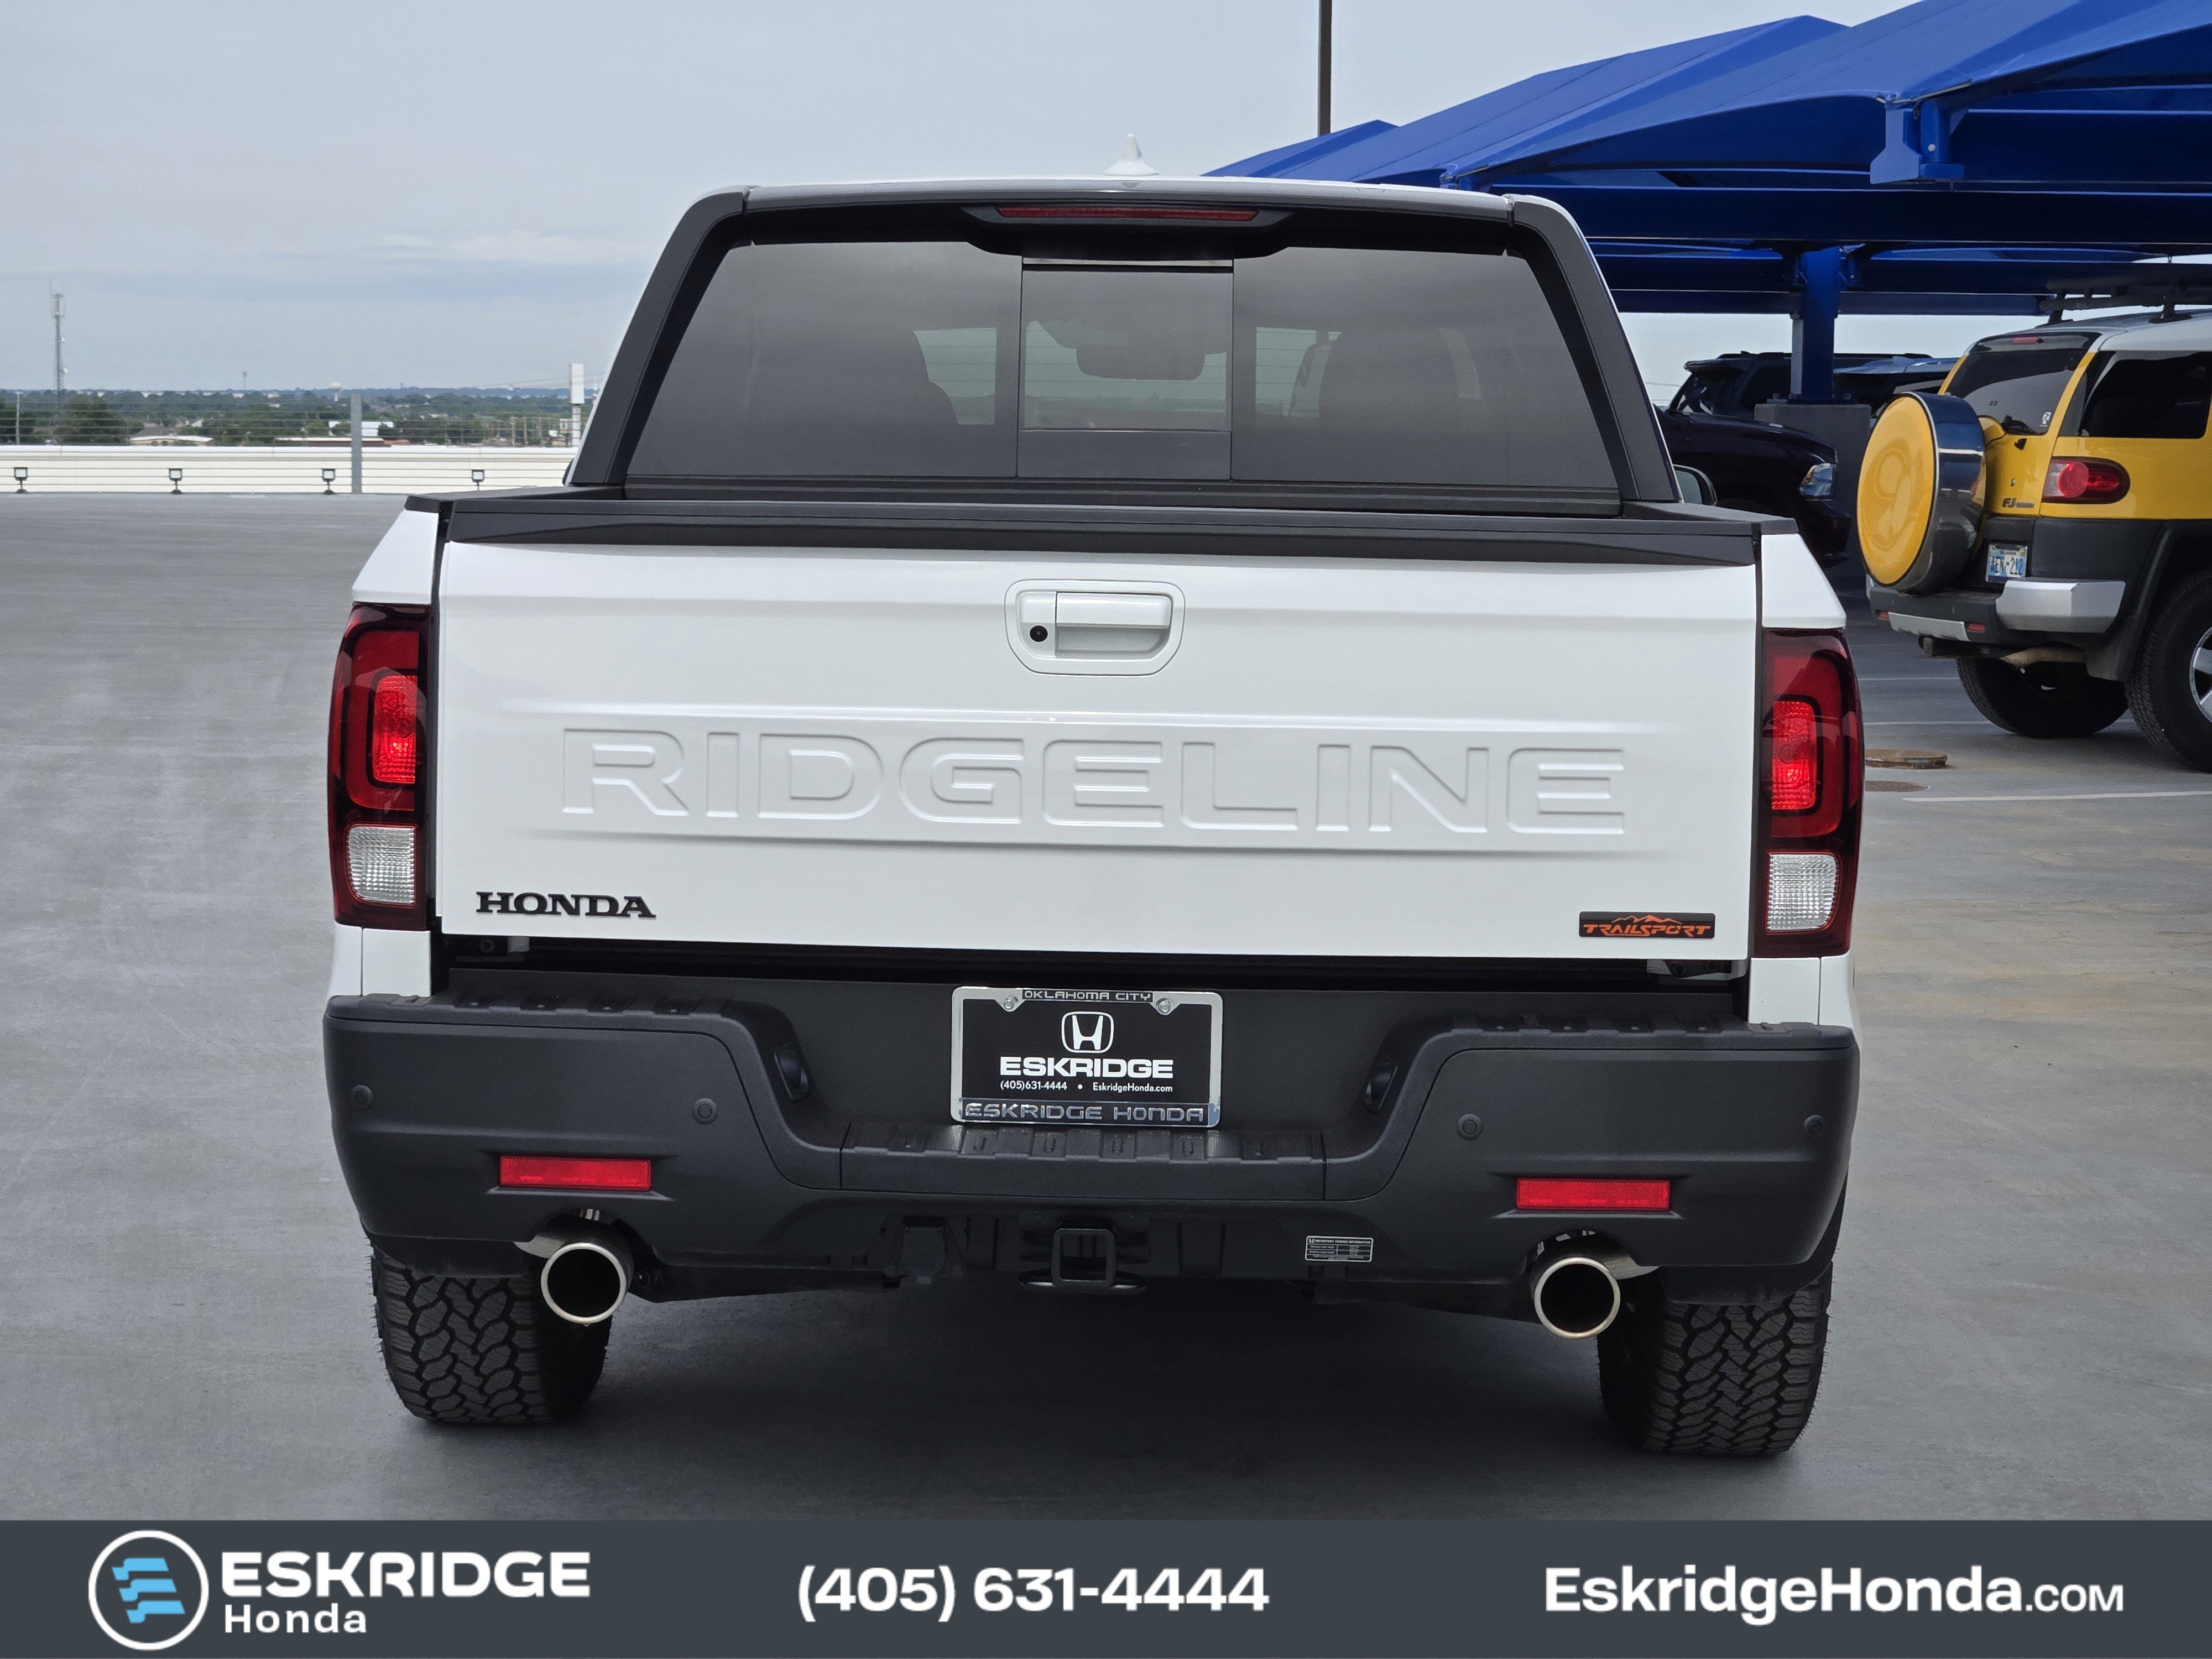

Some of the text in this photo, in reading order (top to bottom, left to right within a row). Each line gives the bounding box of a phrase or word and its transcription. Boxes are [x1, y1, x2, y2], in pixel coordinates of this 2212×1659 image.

[562, 728, 1626, 834] RIDGELINE
[476, 891, 656, 918] HONDA
[1583, 924, 1711, 937] TRAILSPORT
[1024, 990, 1151, 1001] OKLAHOMA CITY
[1000, 1056, 1173, 1078] ESKRIDGE
[1000, 1080, 1173, 1093] (405)631-4444 EskridgeHonda.com
[965, 1103, 1204, 1122] ESKRIDGE HONDA
